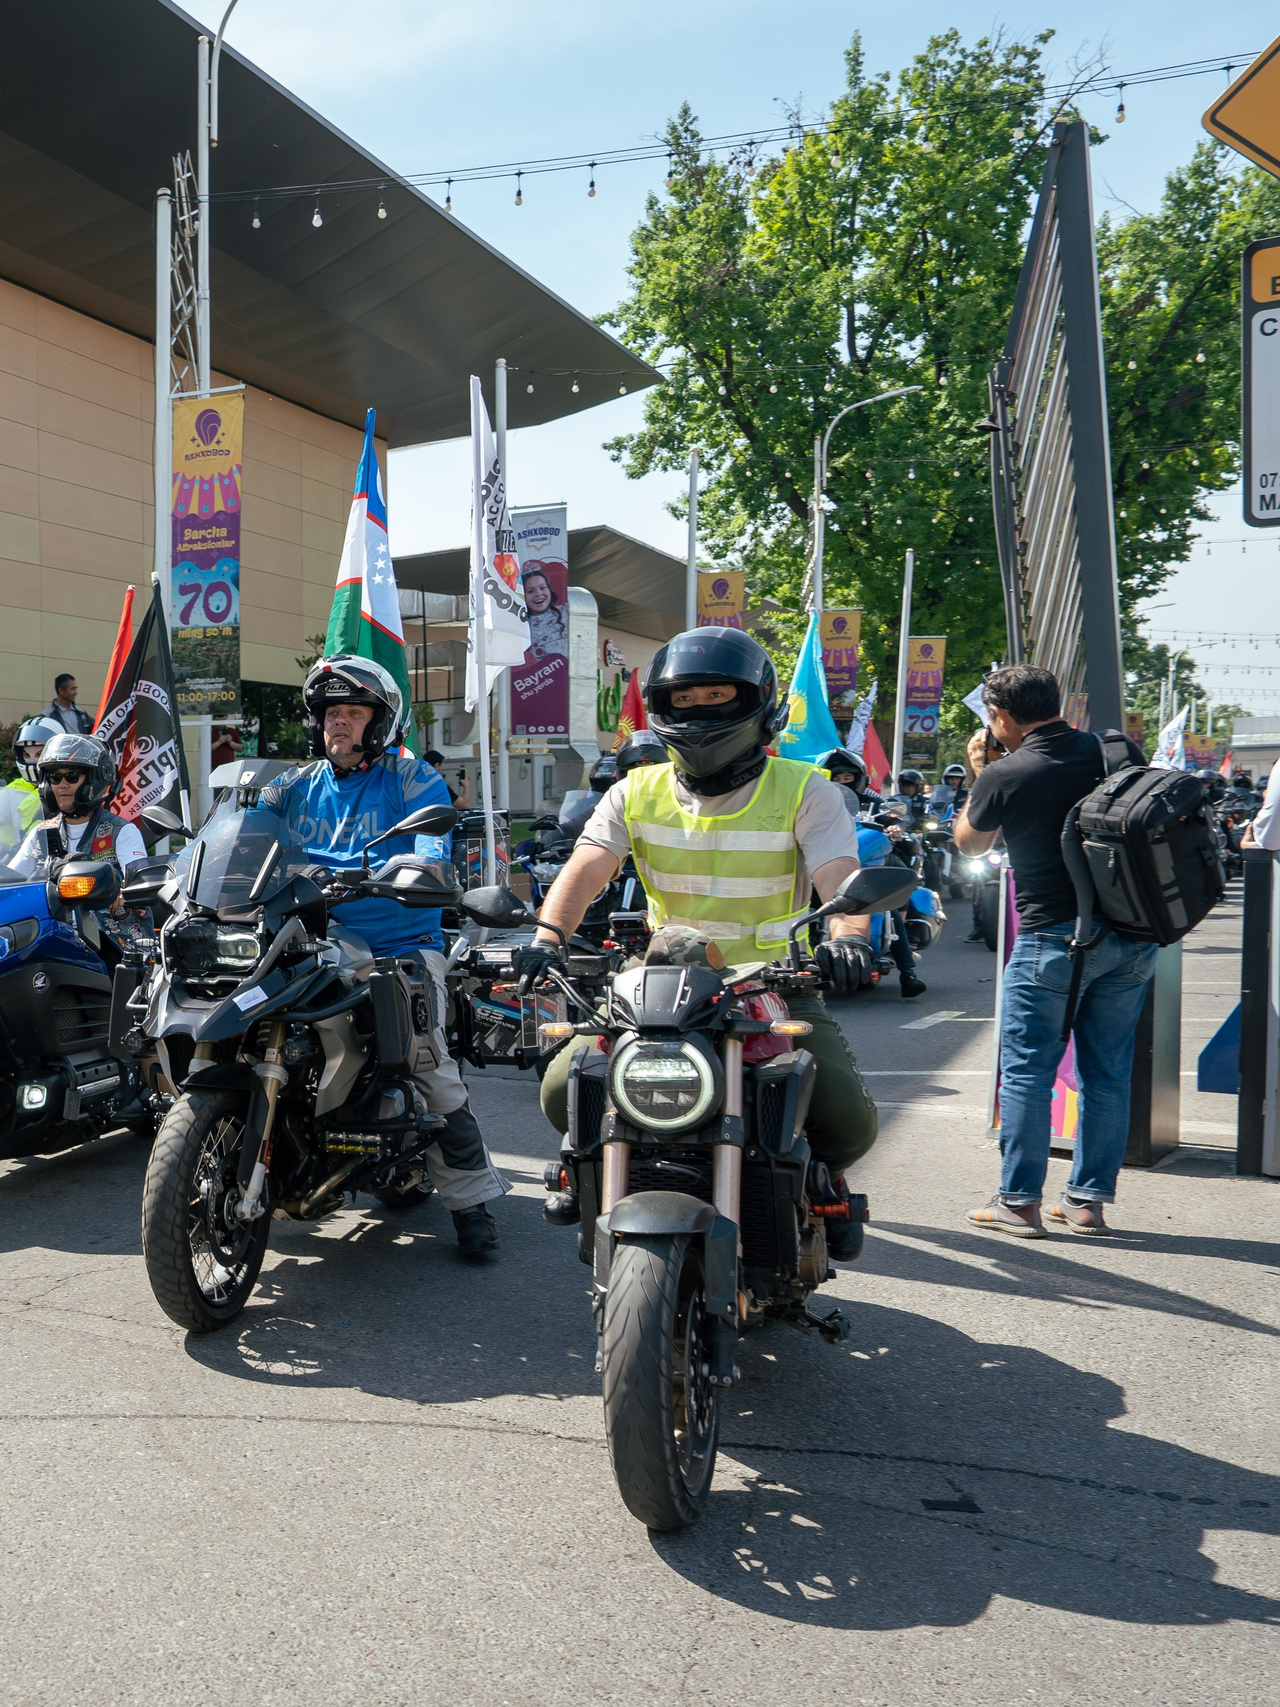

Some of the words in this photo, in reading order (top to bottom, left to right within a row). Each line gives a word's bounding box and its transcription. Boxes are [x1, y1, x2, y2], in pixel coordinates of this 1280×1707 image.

[183, 526, 228, 541] Barcha
[517, 526, 561, 541] ASHXOBOD
[178, 580, 233, 626] 70
[178, 628, 204, 639] ming
[513, 658, 564, 692] Bayram
[176, 690, 236, 703] 11:00-17:00
[520, 689, 534, 700] shu
[534, 677, 554, 694] yerda
[908, 714, 935, 732] 70
[475, 1005, 508, 1020] GS
[476, 1013, 517, 1030] ADVENTURE
